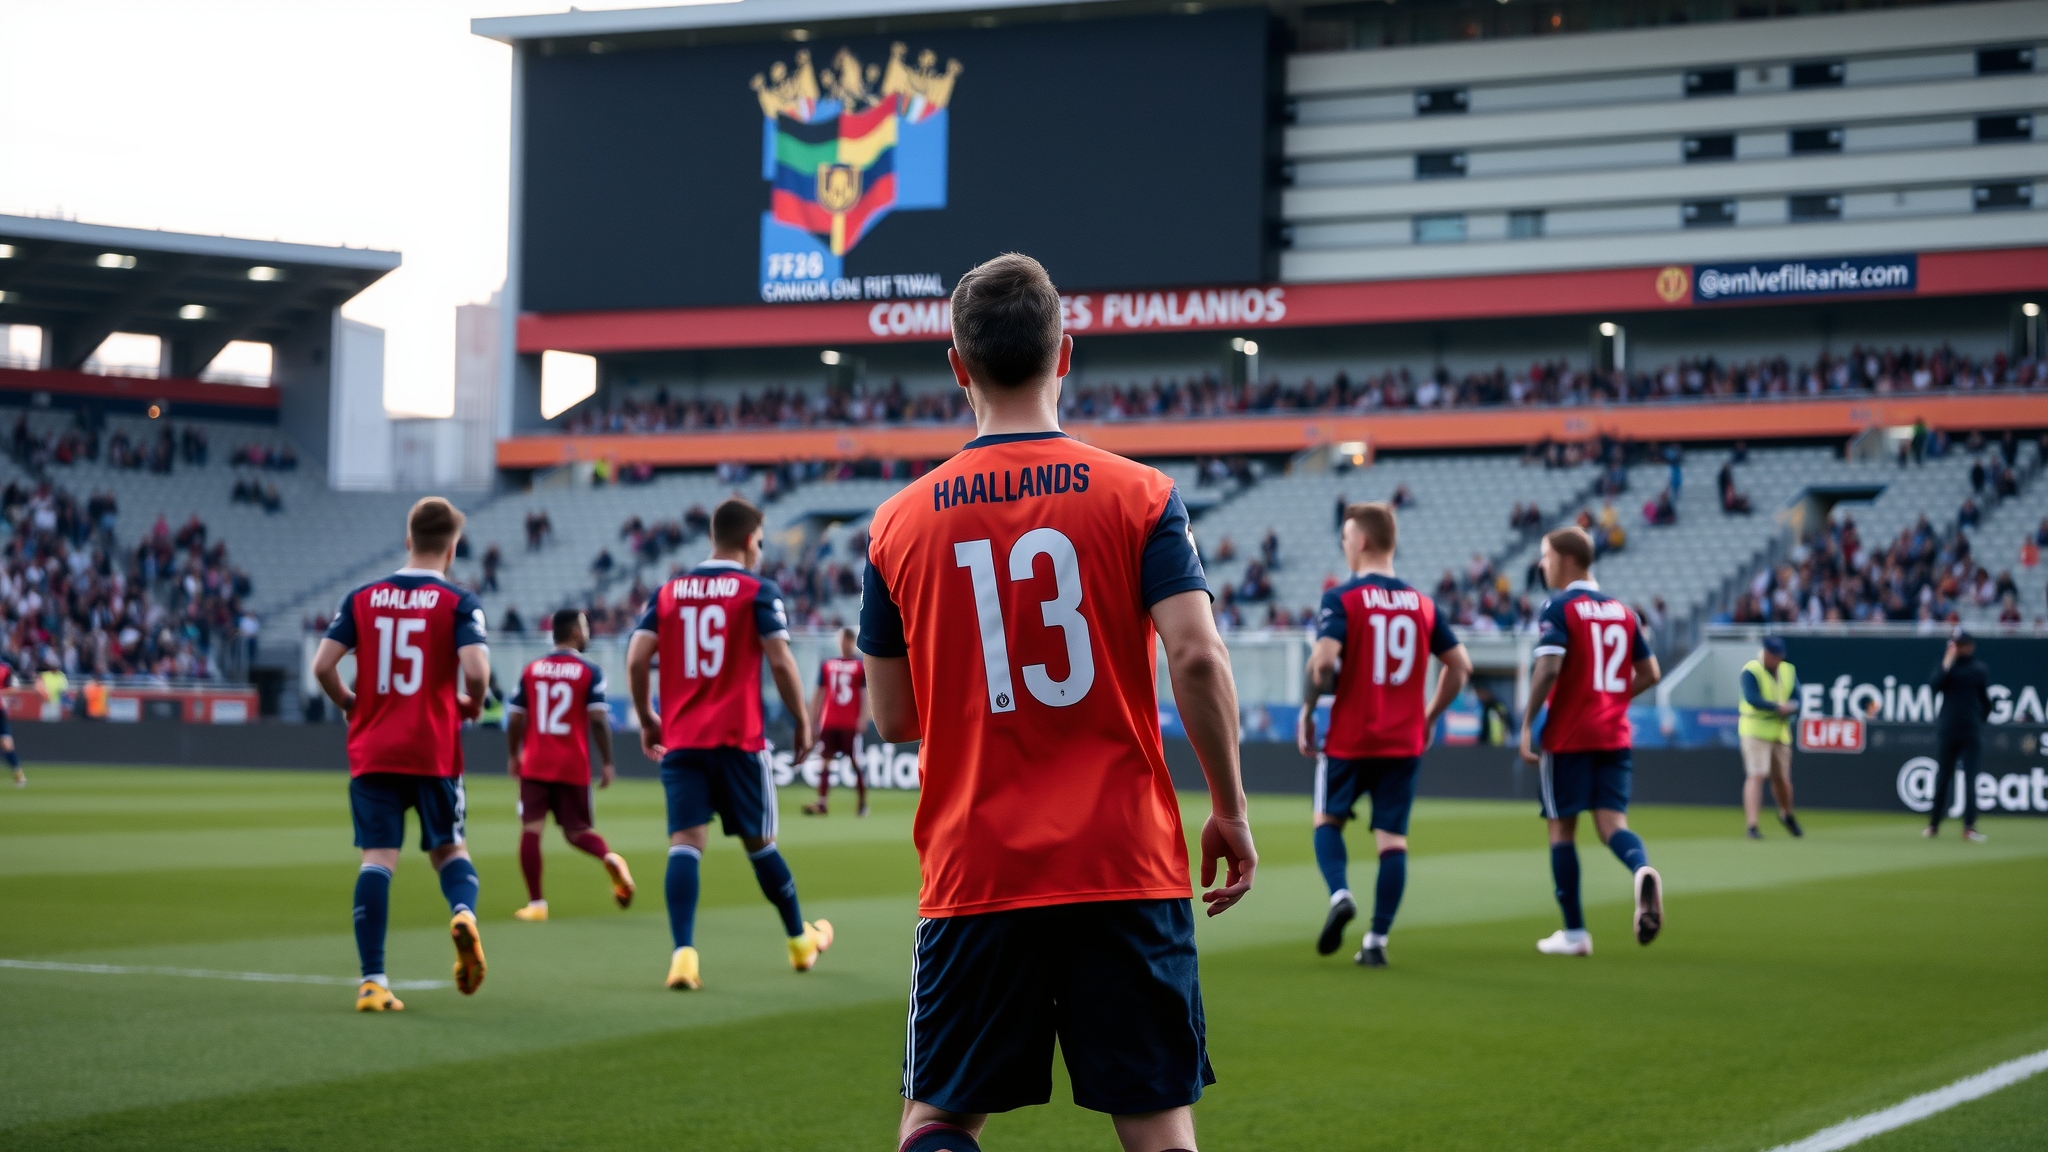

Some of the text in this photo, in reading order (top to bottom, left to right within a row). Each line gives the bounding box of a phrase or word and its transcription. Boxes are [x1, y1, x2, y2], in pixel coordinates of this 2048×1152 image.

[934, 463, 1090, 512] HAALLANDS
[374, 615, 426, 696] 15
[954, 527, 1095, 714] 13
[1368, 613, 1417, 686] 19
[1590, 621, 1628, 693] 12
[534, 680, 573, 735] 12
[1805, 719, 1858, 747] LIFE
